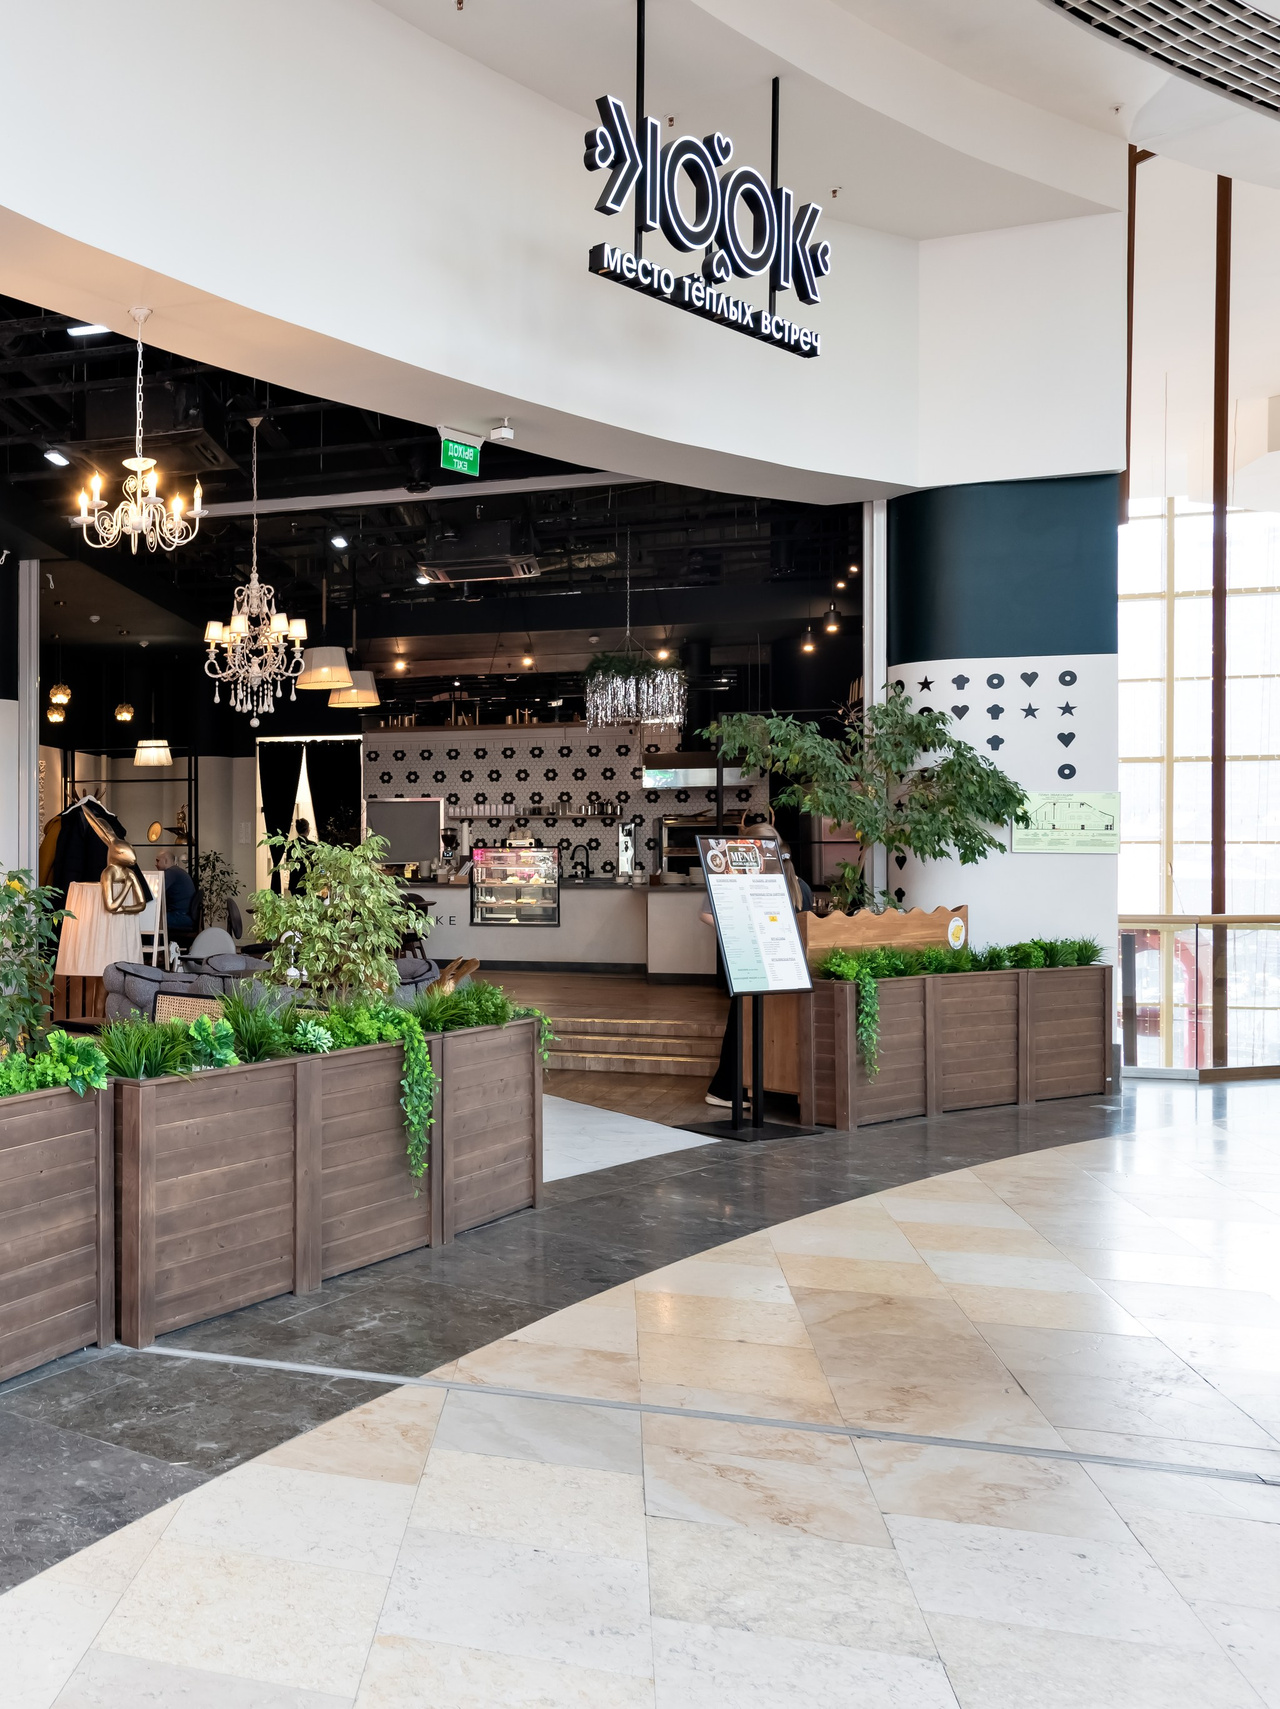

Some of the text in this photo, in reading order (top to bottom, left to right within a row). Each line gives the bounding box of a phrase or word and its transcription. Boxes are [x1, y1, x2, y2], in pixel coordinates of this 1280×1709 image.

[682, 273, 754, 328] тёплых
[761, 310, 821, 356] встреч
[730, 851, 757, 862] MENU
[435, 915, 457, 926] KE
